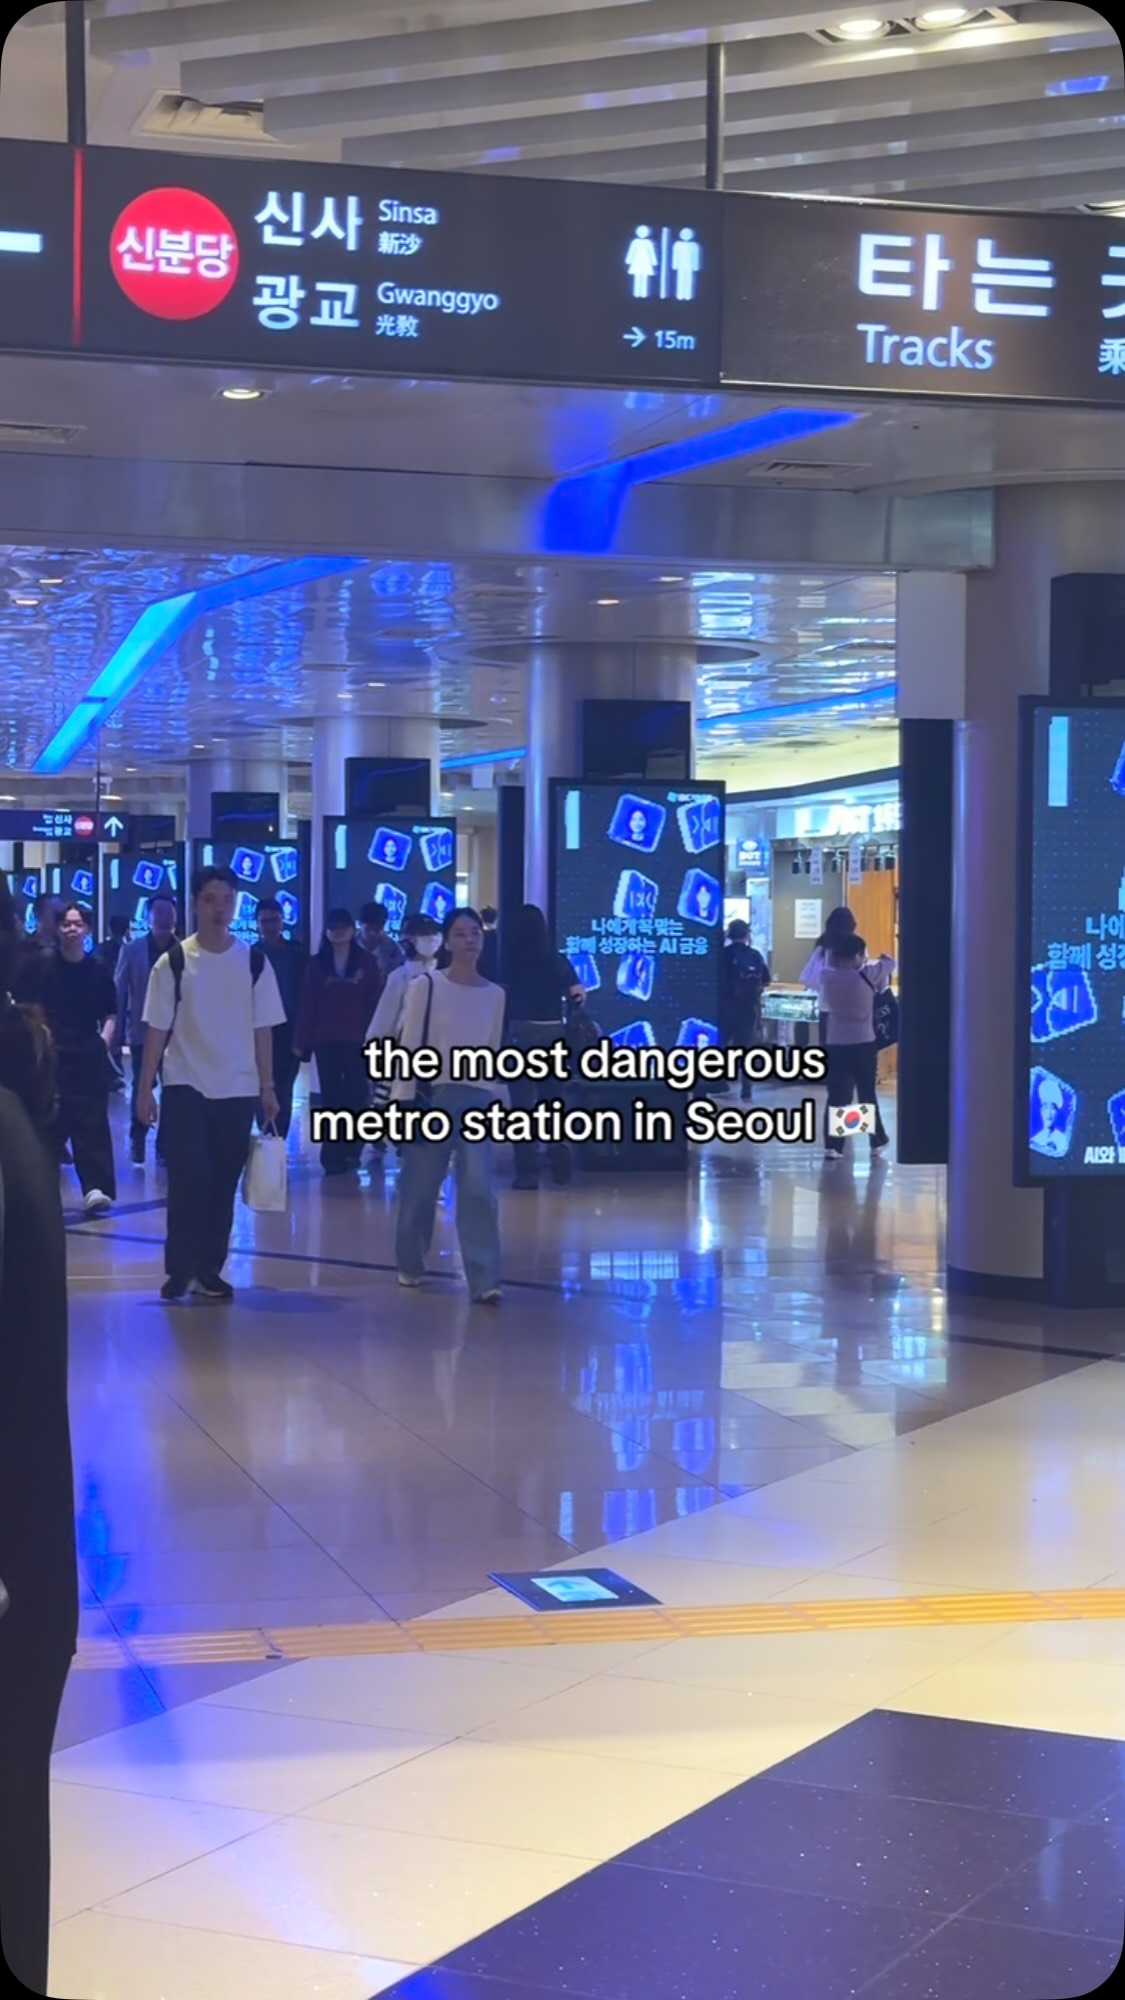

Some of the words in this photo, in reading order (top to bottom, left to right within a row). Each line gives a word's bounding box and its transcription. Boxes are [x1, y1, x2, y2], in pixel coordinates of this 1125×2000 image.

[254, 190, 363, 251] 신사
[378, 199, 438, 225] Sinsa
[116, 226, 235, 279] 신분당
[377, 230, 422, 256] 新沙
[857, 232, 1055, 318] 타는
[252, 274, 361, 330] 광교
[376, 281, 499, 315] Gwanggyo
[654, 330, 695, 350] 15m
[855, 322, 996, 370] Tracks
[591, 917, 637, 936] 나에게
[566, 936, 597, 955] 함께
[598, 936, 656, 955] 성장하는
[659, 937, 677, 954] AI
[679, 936, 709, 955] 금융
[1046, 941, 1092, 970] 함께
